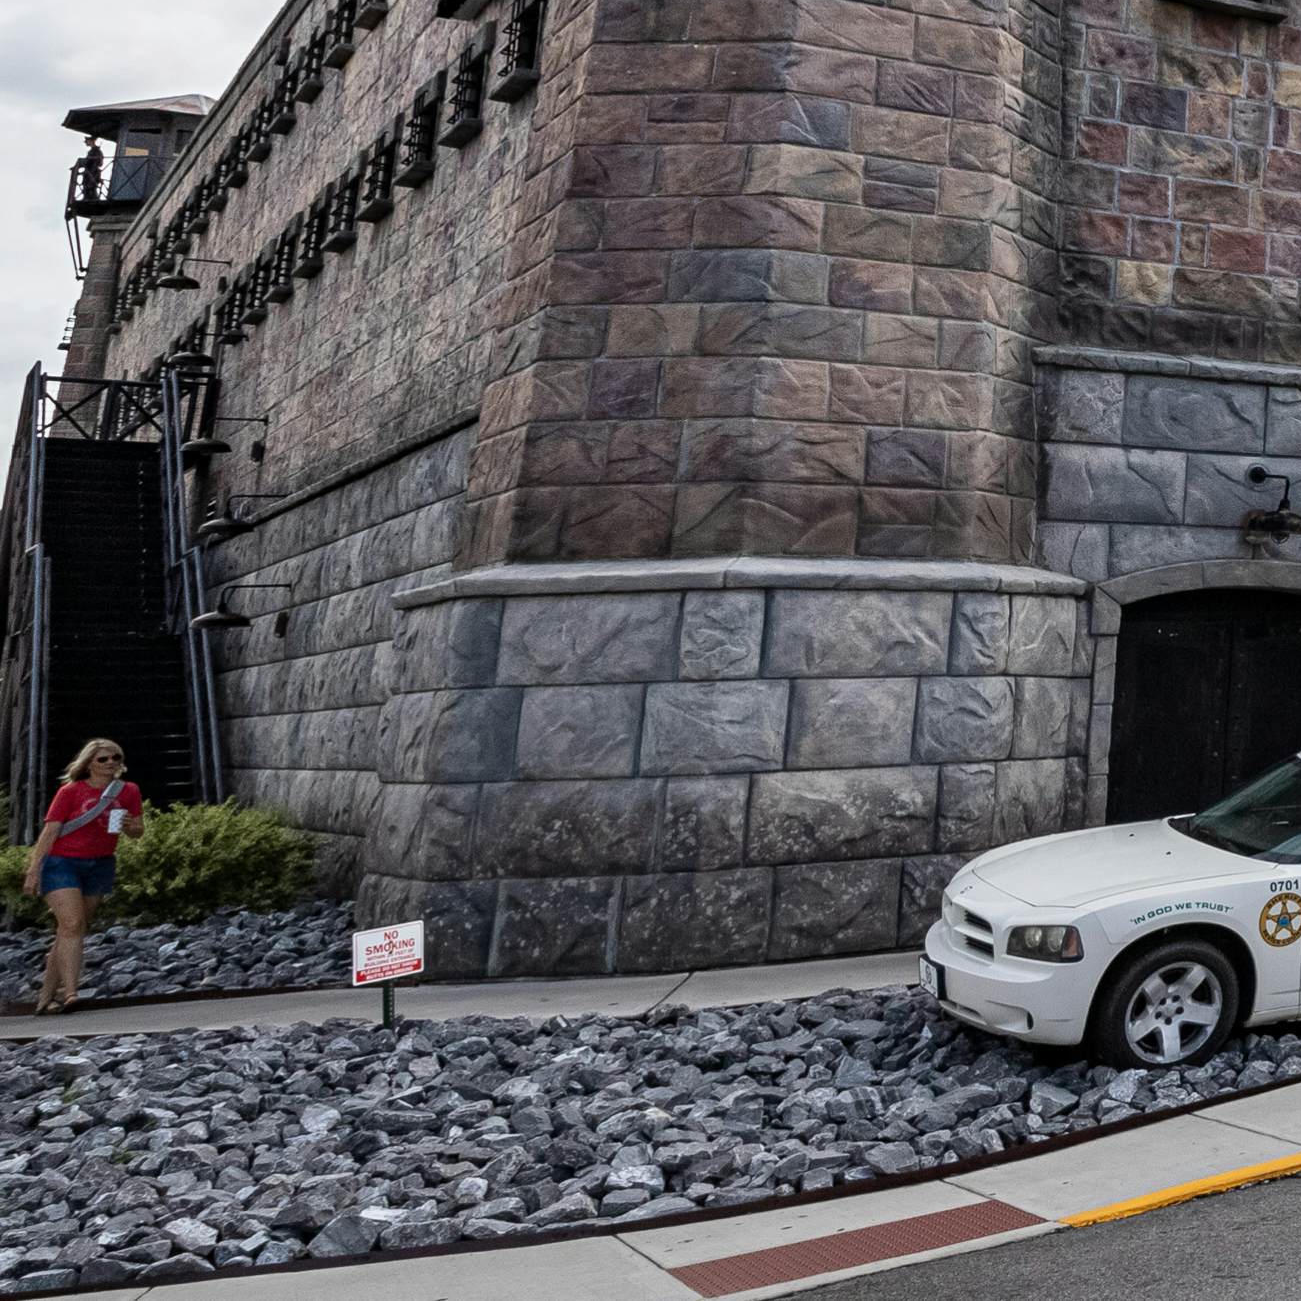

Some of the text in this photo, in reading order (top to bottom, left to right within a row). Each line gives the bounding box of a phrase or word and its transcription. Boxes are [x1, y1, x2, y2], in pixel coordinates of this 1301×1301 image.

[1269, 879, 1300, 892] 0701
[1148, 905, 1173, 920] GOD
[1175, 902, 1193, 912] WE
[384, 930, 399, 940] NO
[365, 938, 415, 956] SMOKING
